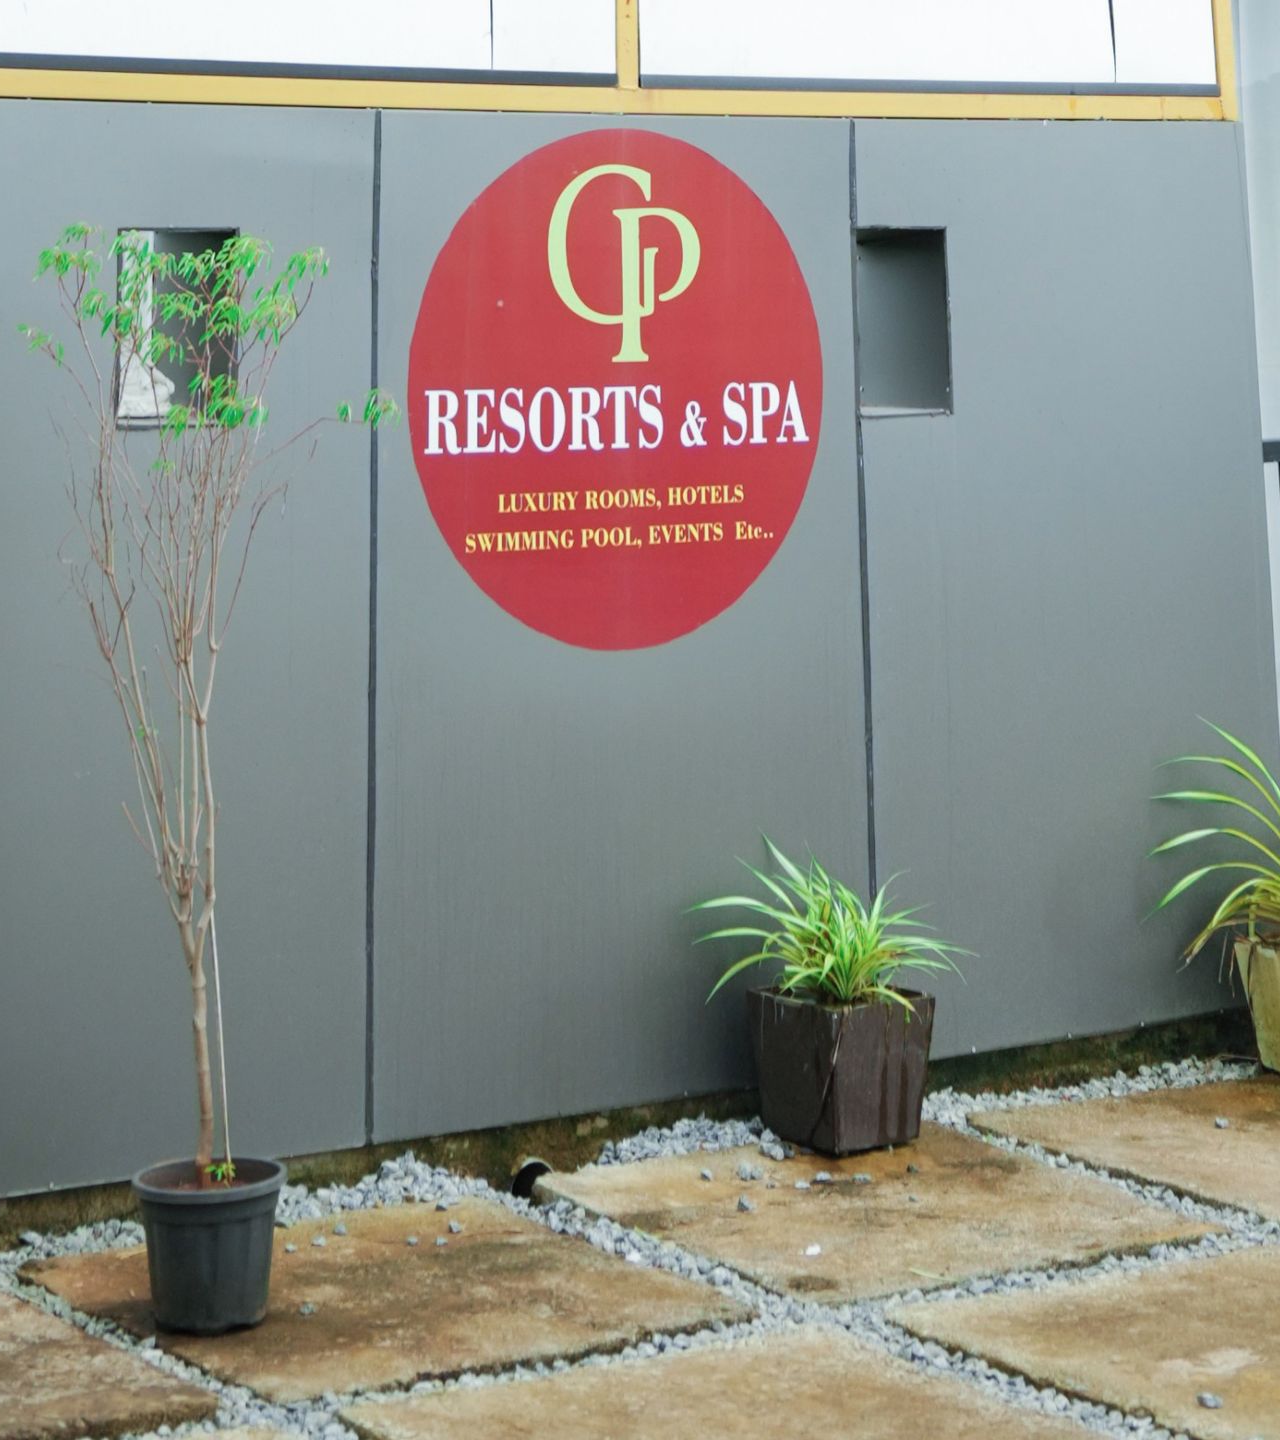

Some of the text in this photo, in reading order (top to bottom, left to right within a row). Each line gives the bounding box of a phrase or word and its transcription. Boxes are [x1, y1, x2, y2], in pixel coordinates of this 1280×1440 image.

[423, 380, 811, 455] RESORTS & SPA
[498, 484, 745, 513] LUXURY ROOMS, HOTELS
[465, 529, 574, 553] SWIMMING
[581, 526, 642, 548] POOL,
[649, 522, 724, 545] EVENTS
